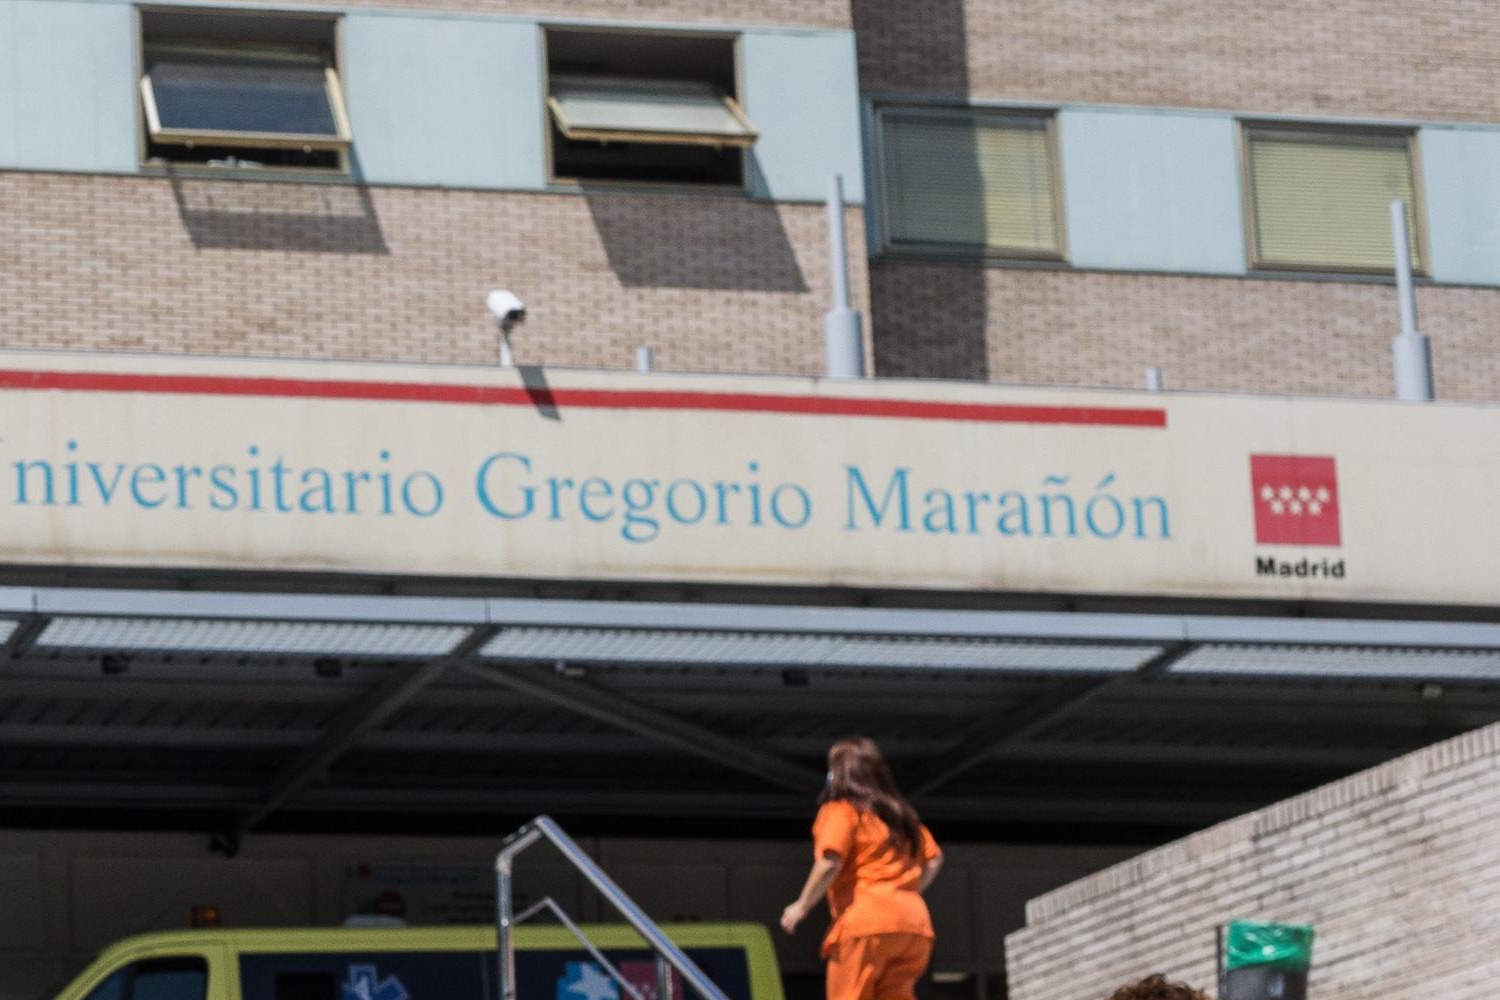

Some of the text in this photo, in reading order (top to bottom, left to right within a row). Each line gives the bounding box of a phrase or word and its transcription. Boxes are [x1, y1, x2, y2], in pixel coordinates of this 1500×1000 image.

[474, 451, 813, 543] Gregorio
[844, 464, 1172, 541] Marañón
[1256, 556, 1345, 578] Madrid
